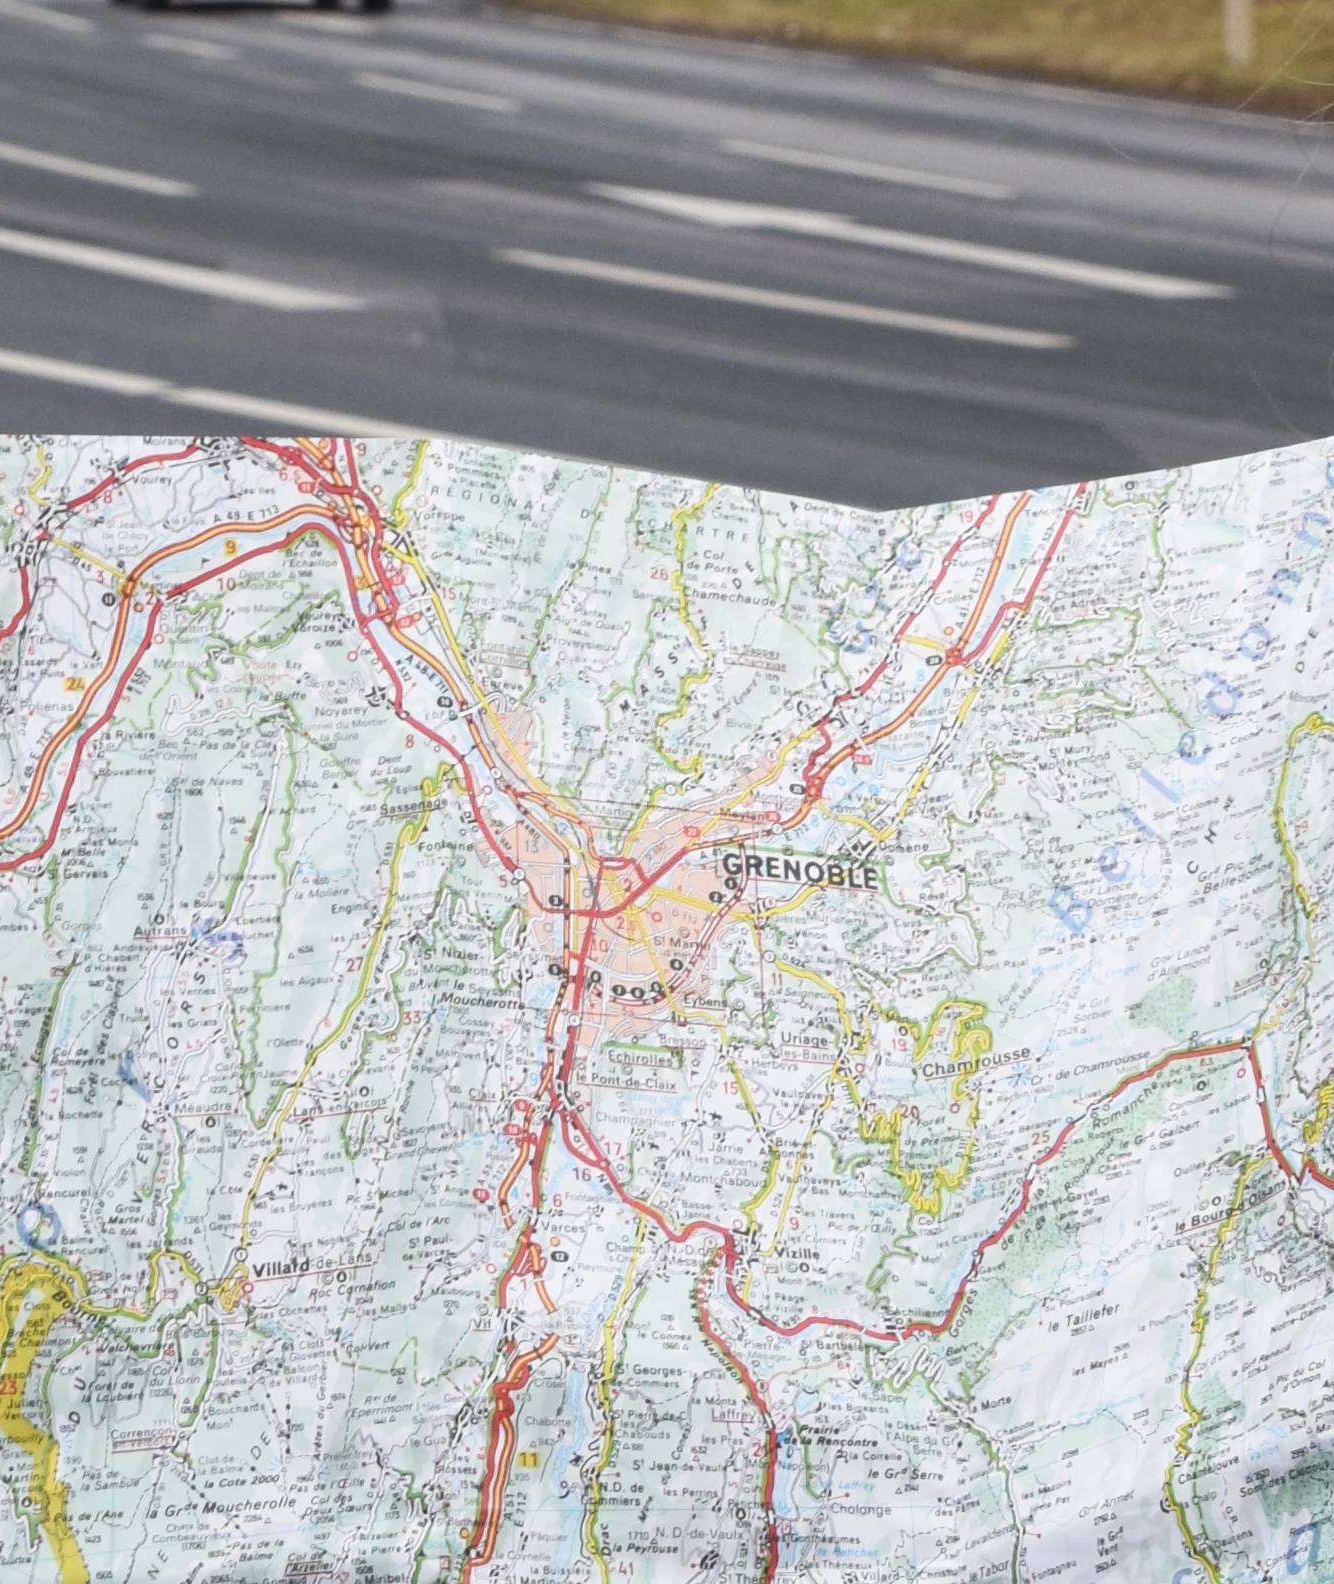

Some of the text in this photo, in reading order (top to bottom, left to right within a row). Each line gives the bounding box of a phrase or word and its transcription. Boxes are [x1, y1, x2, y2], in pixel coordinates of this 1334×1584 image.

[224, 539, 235, 554] 9
[704, 550, 724, 560] Col
[652, 567, 667, 580] 26
[687, 561, 738, 575] de Porte
[217, 577, 236, 590] 10
[441, 587, 456, 600] 15
[66, 677, 85, 691] 24
[315, 706, 367, 717] Noyarey
[405, 735, 414, 747] 8
[380, 798, 448, 814] Sassenage
[419, 841, 473, 852] Fontaine
[722, 853, 878, 889] GRENOBLE
[135, 925, 187, 936] Autrans
[347, 958, 362, 972] 27
[772, 973, 782, 985] 11
[441, 993, 525, 1010] Moucherotte
[684, 996, 728, 1008] Eybens
[404, 1011, 422, 1024] 33
[781, 1032, 832, 1047] Uriage-
[892, 1038, 906, 1051] 19
[923, 1045, 1031, 1077] Chamrousse
[1074, 1049, 1150, 1076] Chamrousse
[724, 1081, 738, 1095] 15
[1032, 1132, 1050, 1145] 25
[572, 1168, 592, 1182] 16
[542, 1221, 585, 1234] Varces
[776, 1247, 819, 1260] Vizille
[309, 1288, 331, 1299] Roc
[1048, 1301, 1120, 1332] le Taillefer
[474, 1319, 491, 1329] Vif
[0, 1381, 17, 1394] 23
[799, 1424, 839, 1436] Prairie
[815, 1436, 878, 1448] Rencontre
[521, 1452, 538, 1467] 11
[203, 1496, 296, 1513] Moucherolle
[618, 1562, 633, 1576] 41
